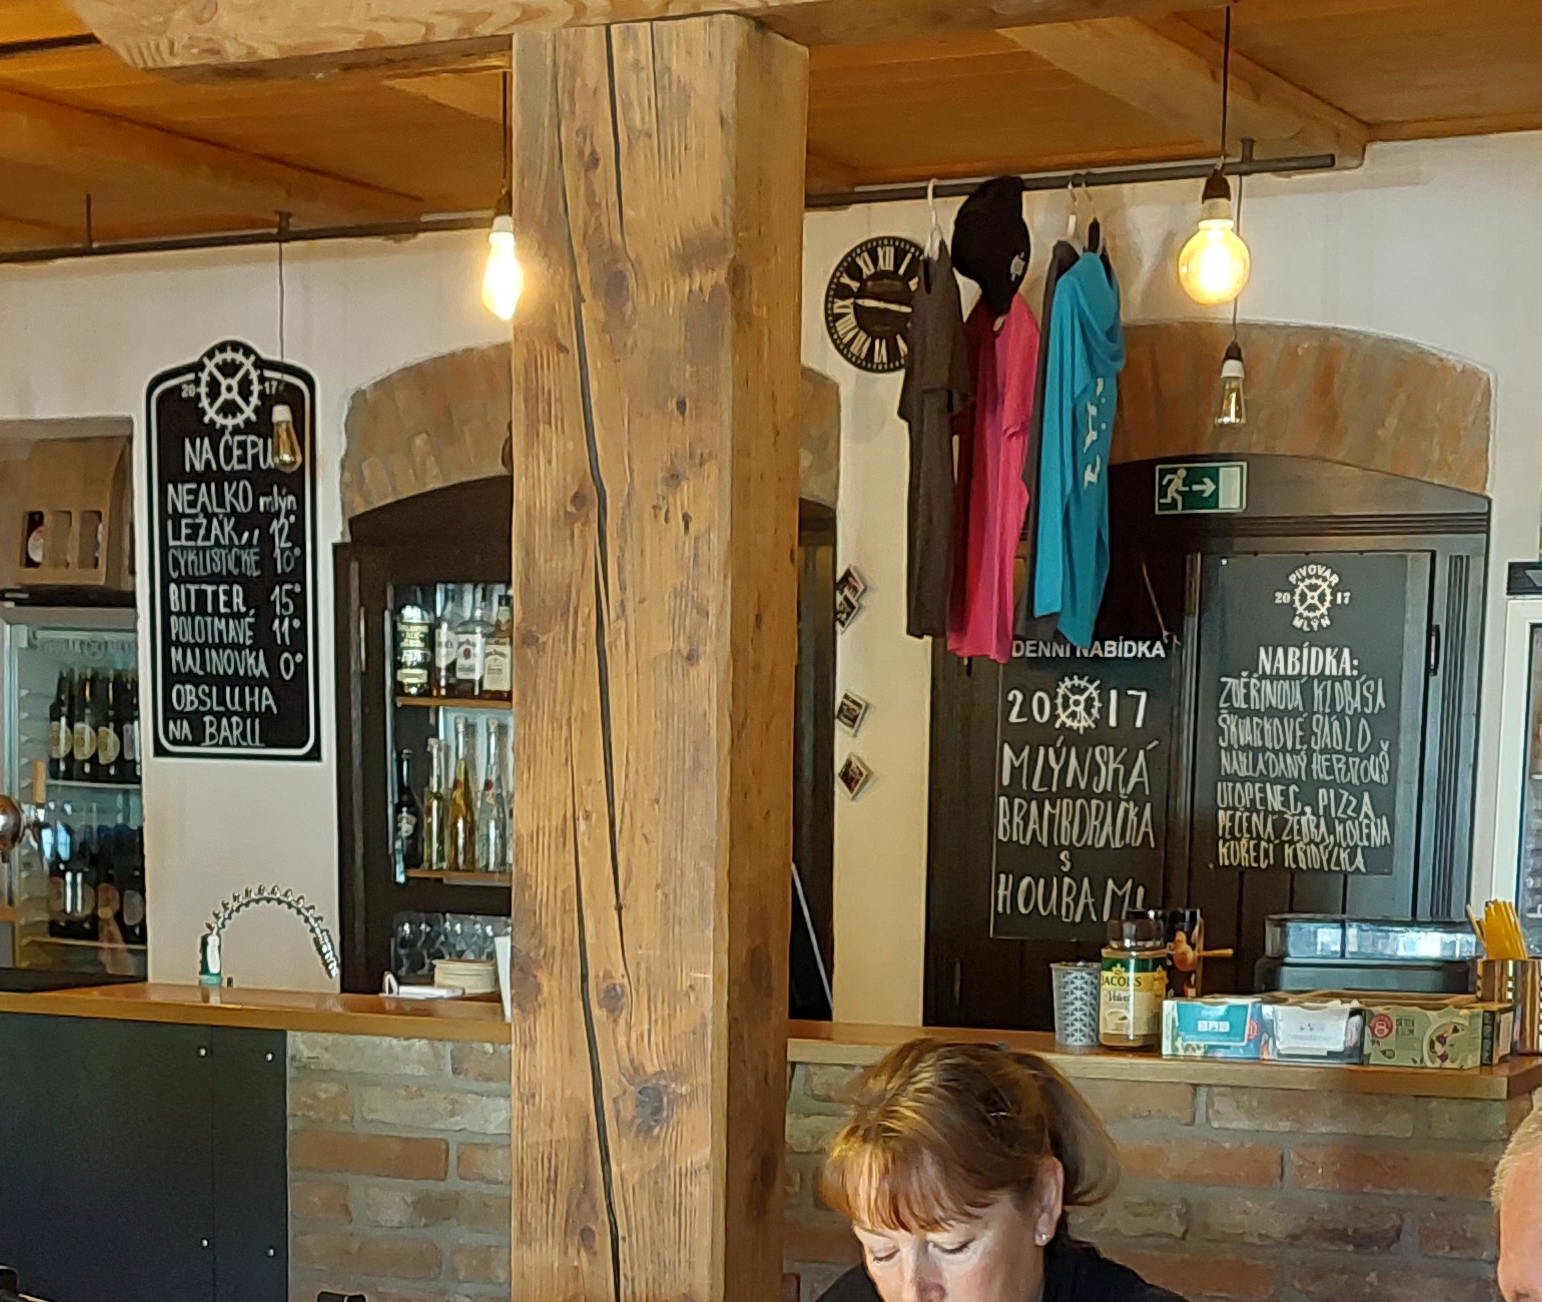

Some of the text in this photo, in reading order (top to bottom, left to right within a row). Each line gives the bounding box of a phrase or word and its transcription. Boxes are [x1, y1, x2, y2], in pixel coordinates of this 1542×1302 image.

[181, 380, 277, 397] 20 17
[184, 436, 216, 472] NA
[167, 479, 252, 513] NEALKO
[1288, 563, 1340, 586] PIVOVAR
[1274, 591, 1351, 605] 20 17
[170, 609, 255, 645] POLOTMAVÉ
[171, 645, 269, 678] MALINOVKA
[1259, 641, 1359, 676] NABÍDKA:
[171, 683, 277, 714] OBSLUHA
[1007, 688, 1147, 728] 20 17
[168, 714, 264, 746] NA BARU
[1001, 736, 1159, 795] MLÝNSKÁ
[997, 790, 1155, 847] BRAMBORAČKA
[1318, 787, 1376, 821] PIZZA
[1101, 975, 1142, 987] JACOS
